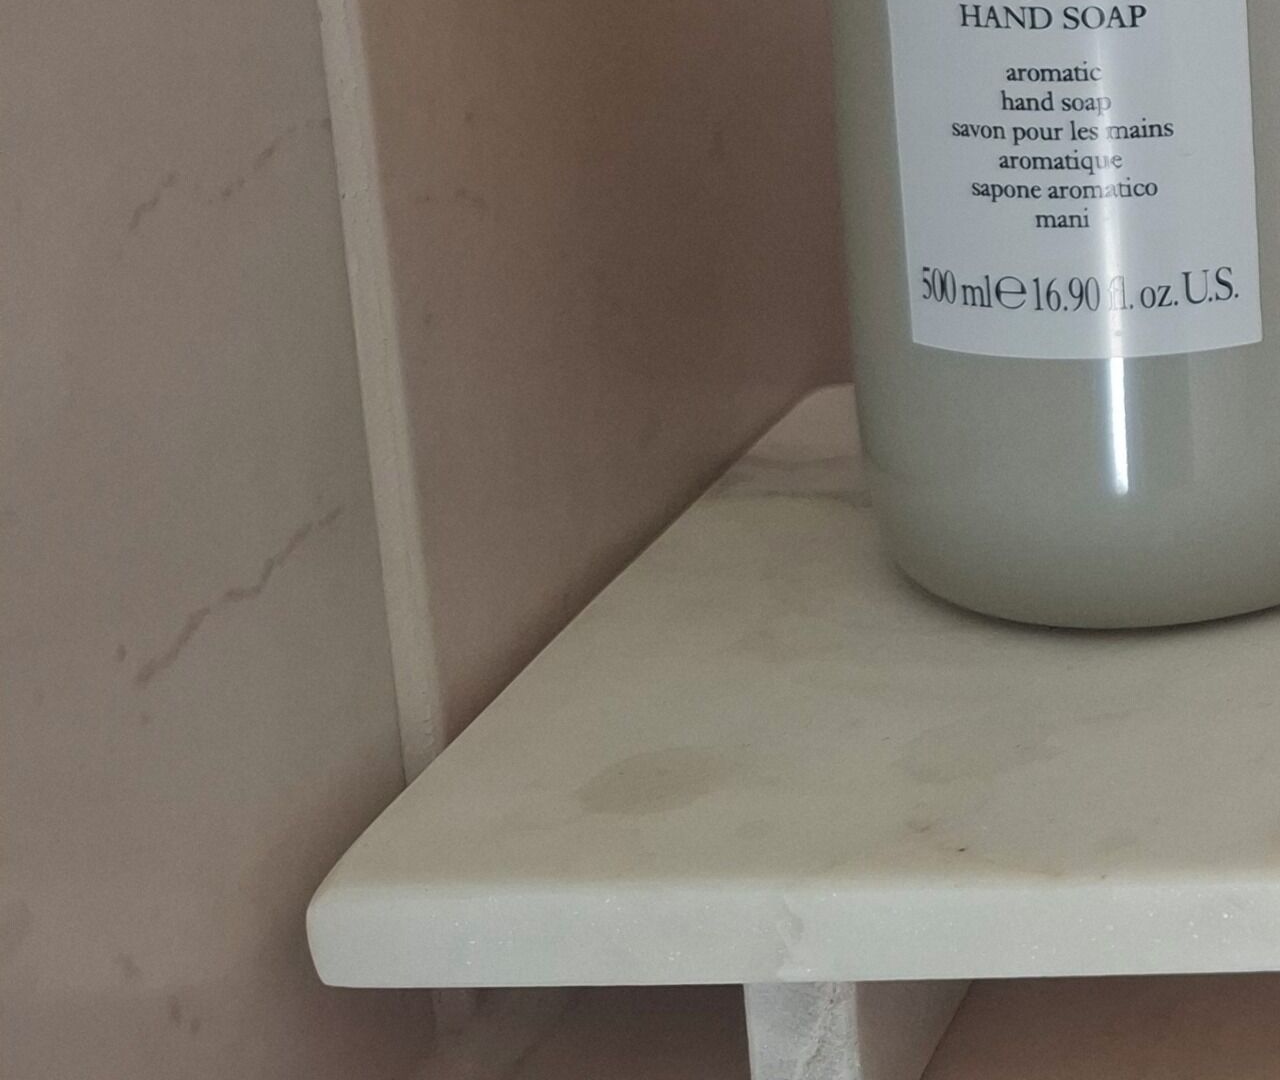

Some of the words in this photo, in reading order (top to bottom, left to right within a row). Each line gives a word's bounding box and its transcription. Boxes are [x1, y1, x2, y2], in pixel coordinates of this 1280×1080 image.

[959, 3, 1053, 30] HAND
[1062, 4, 1148, 31] SOAP
[1005, 60, 1101, 83] aromatic
[999, 89, 1055, 112] hand
[1060, 97, 1112, 115] soap
[951, 122, 1007, 140] savon
[1011, 126, 1064, 147] pour
[1069, 119, 1099, 142] les
[1106, 117, 1175, 140] mains
[998, 148, 1123, 176] aromatique
[971, 182, 1042, 204] sapone
[1047, 179, 1159, 200] aromatico
[1034, 208, 1091, 229] mani
[921, 266, 957, 305] 500
[960, 274, 993, 309] ml
[1032, 276, 1101, 313] 16.90
[1139, 284, 1179, 310] oz.
[1181, 266, 1240, 305] U.S.
